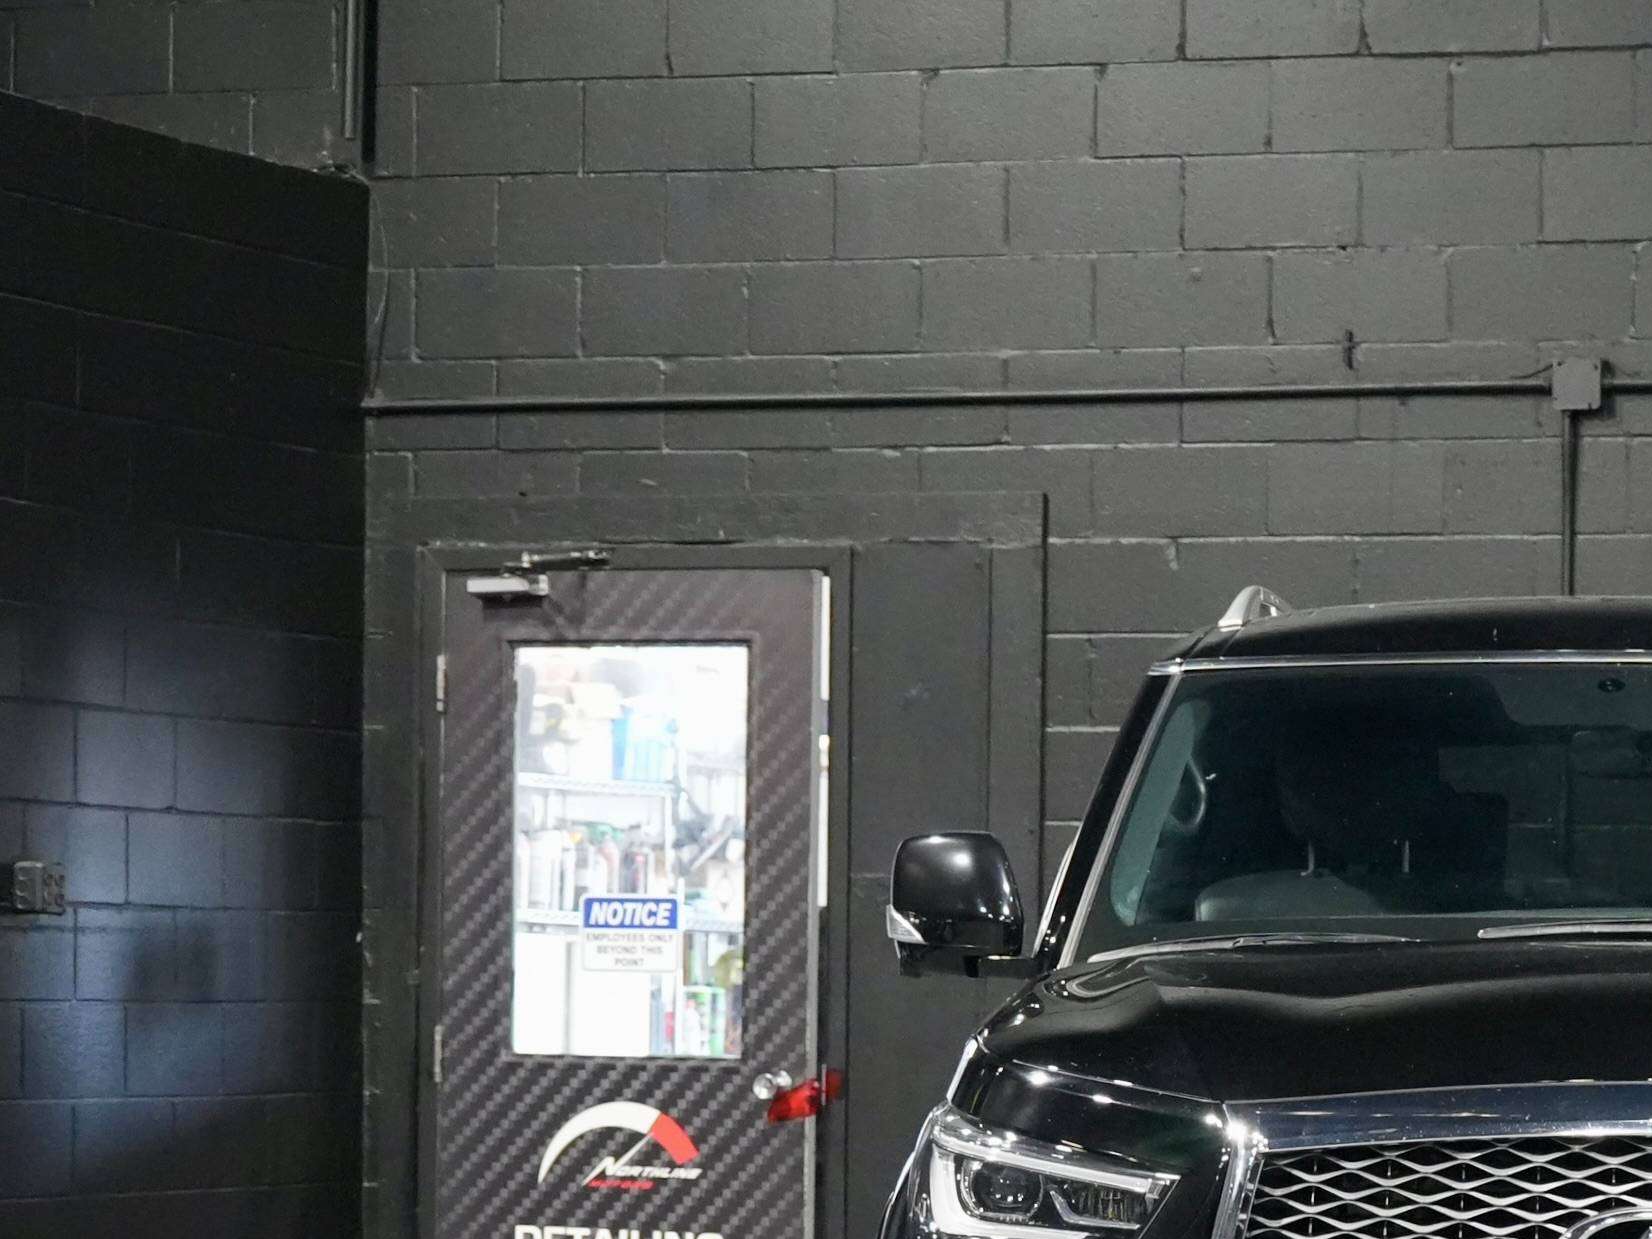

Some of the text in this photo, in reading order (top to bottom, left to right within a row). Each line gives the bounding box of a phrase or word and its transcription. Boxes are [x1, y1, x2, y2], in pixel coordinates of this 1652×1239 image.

[589, 901, 672, 927] NOTICE
[586, 932, 674, 943] EMPLOYEES ONLY
[596, 945, 663, 954] BEYOND THIS
[614, 957, 644, 967] POINT
